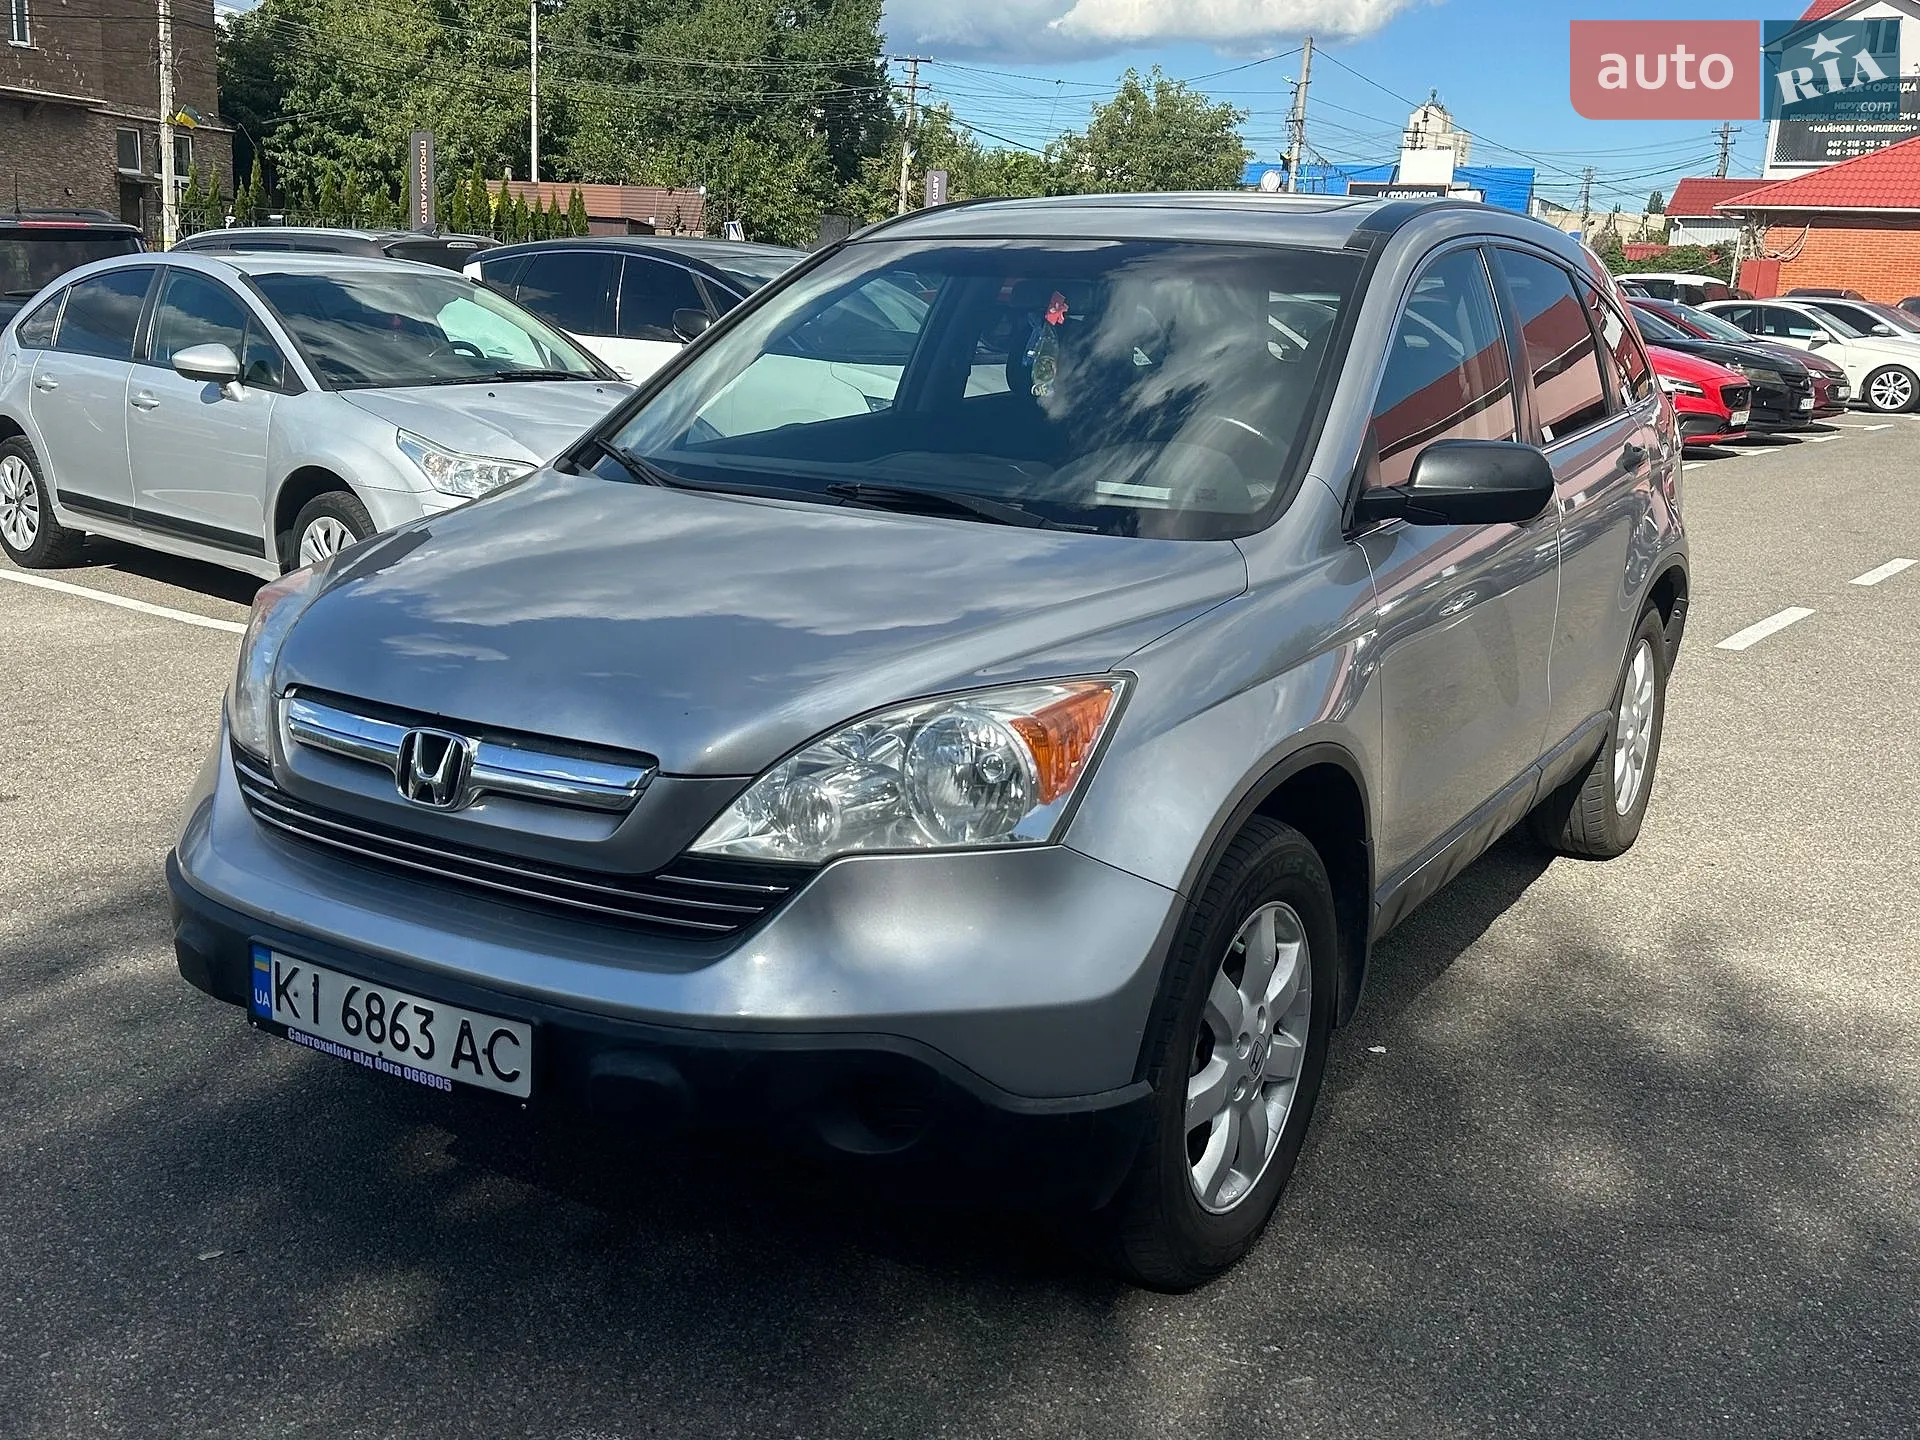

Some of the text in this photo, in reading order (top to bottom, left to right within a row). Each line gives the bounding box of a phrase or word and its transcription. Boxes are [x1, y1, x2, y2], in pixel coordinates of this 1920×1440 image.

[1872, 82, 1917, 93] ОРЕНДА
[1813, 123, 1912, 133] МАЙНОВІ КОМПЛЕКСИ
[254, 988, 270, 1008] UA
[341, 985, 435, 1061] 6863
[287, 1027, 452, 1092] Сантехніки від бога 066905
